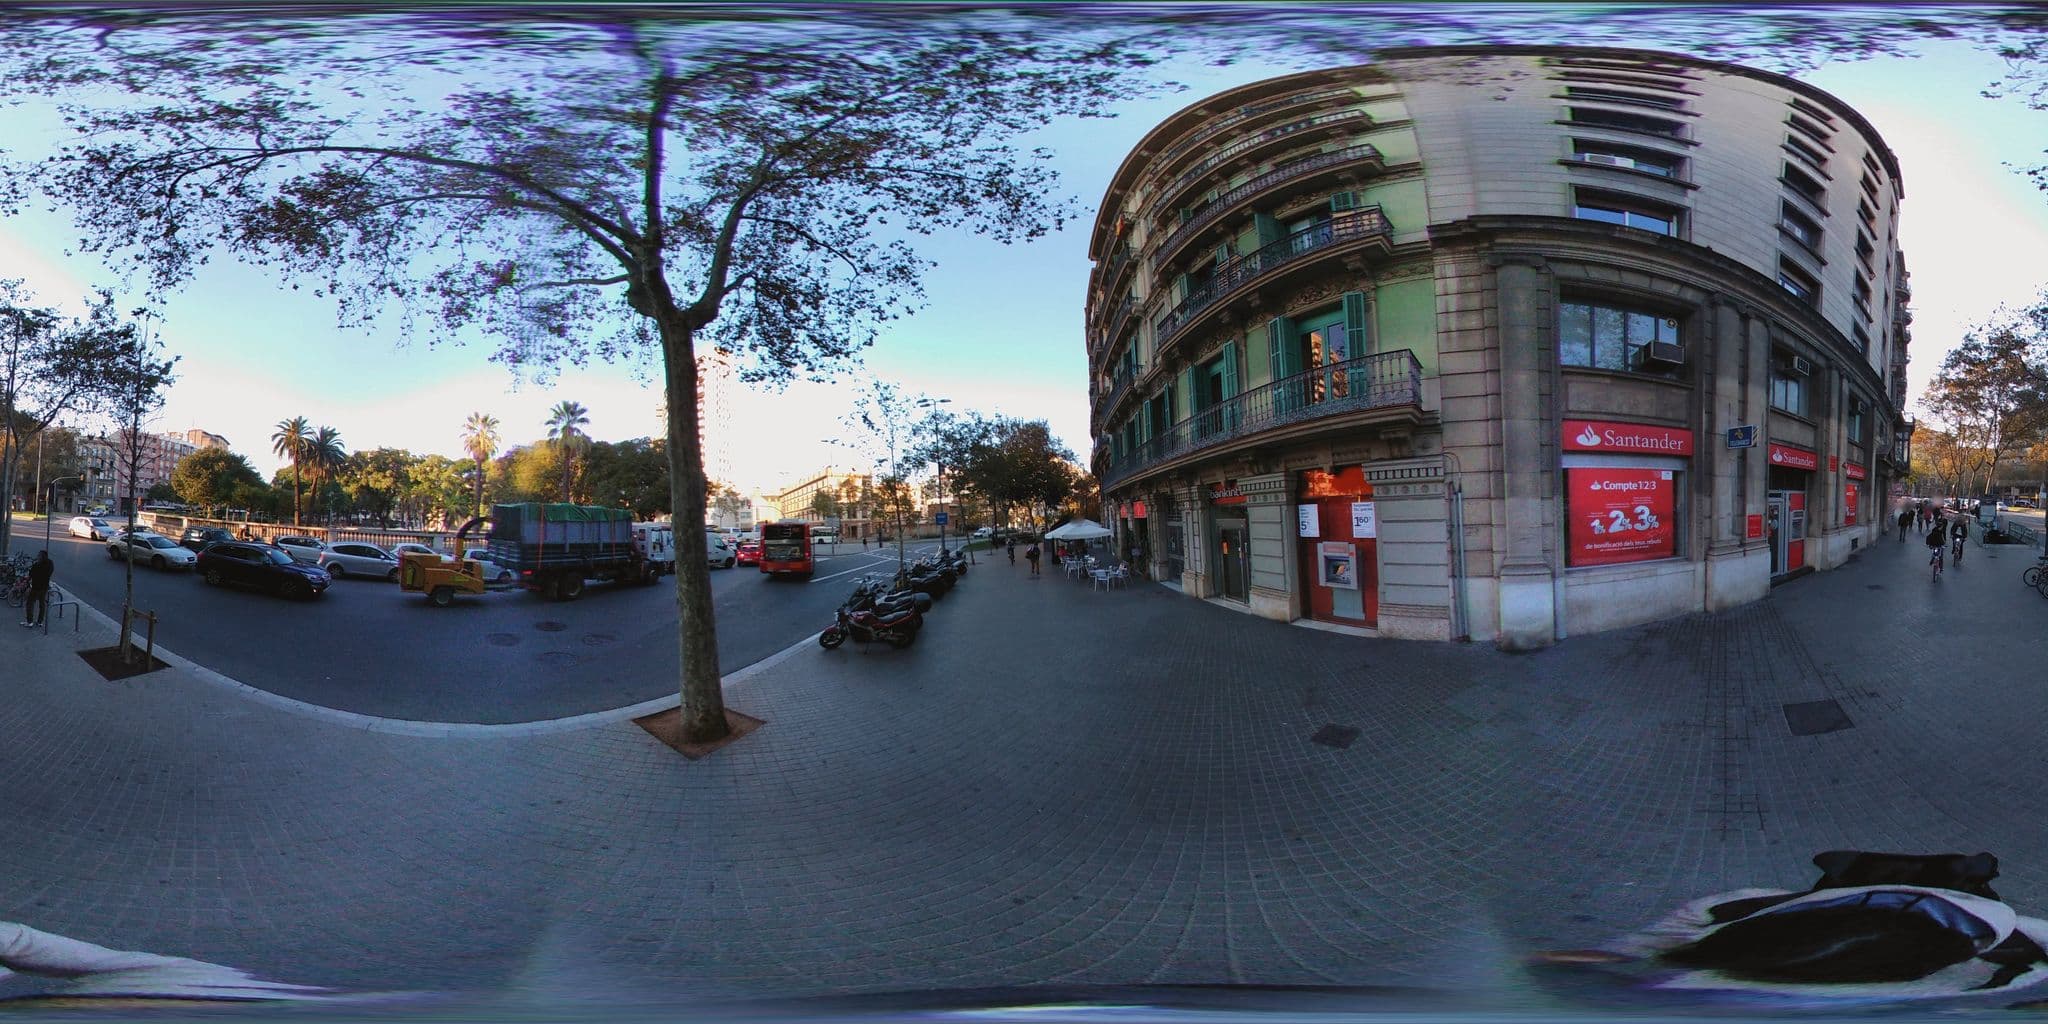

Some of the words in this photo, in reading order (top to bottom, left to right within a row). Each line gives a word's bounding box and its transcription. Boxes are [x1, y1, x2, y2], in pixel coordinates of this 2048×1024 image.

[1604, 430, 1684, 450] Santander
[1783, 452, 1814, 467] Santander
[1603, 480, 1638, 492] Compte
[1608, 510, 1633, 533] 2%
[1634, 505, 1660, 531] 3%
